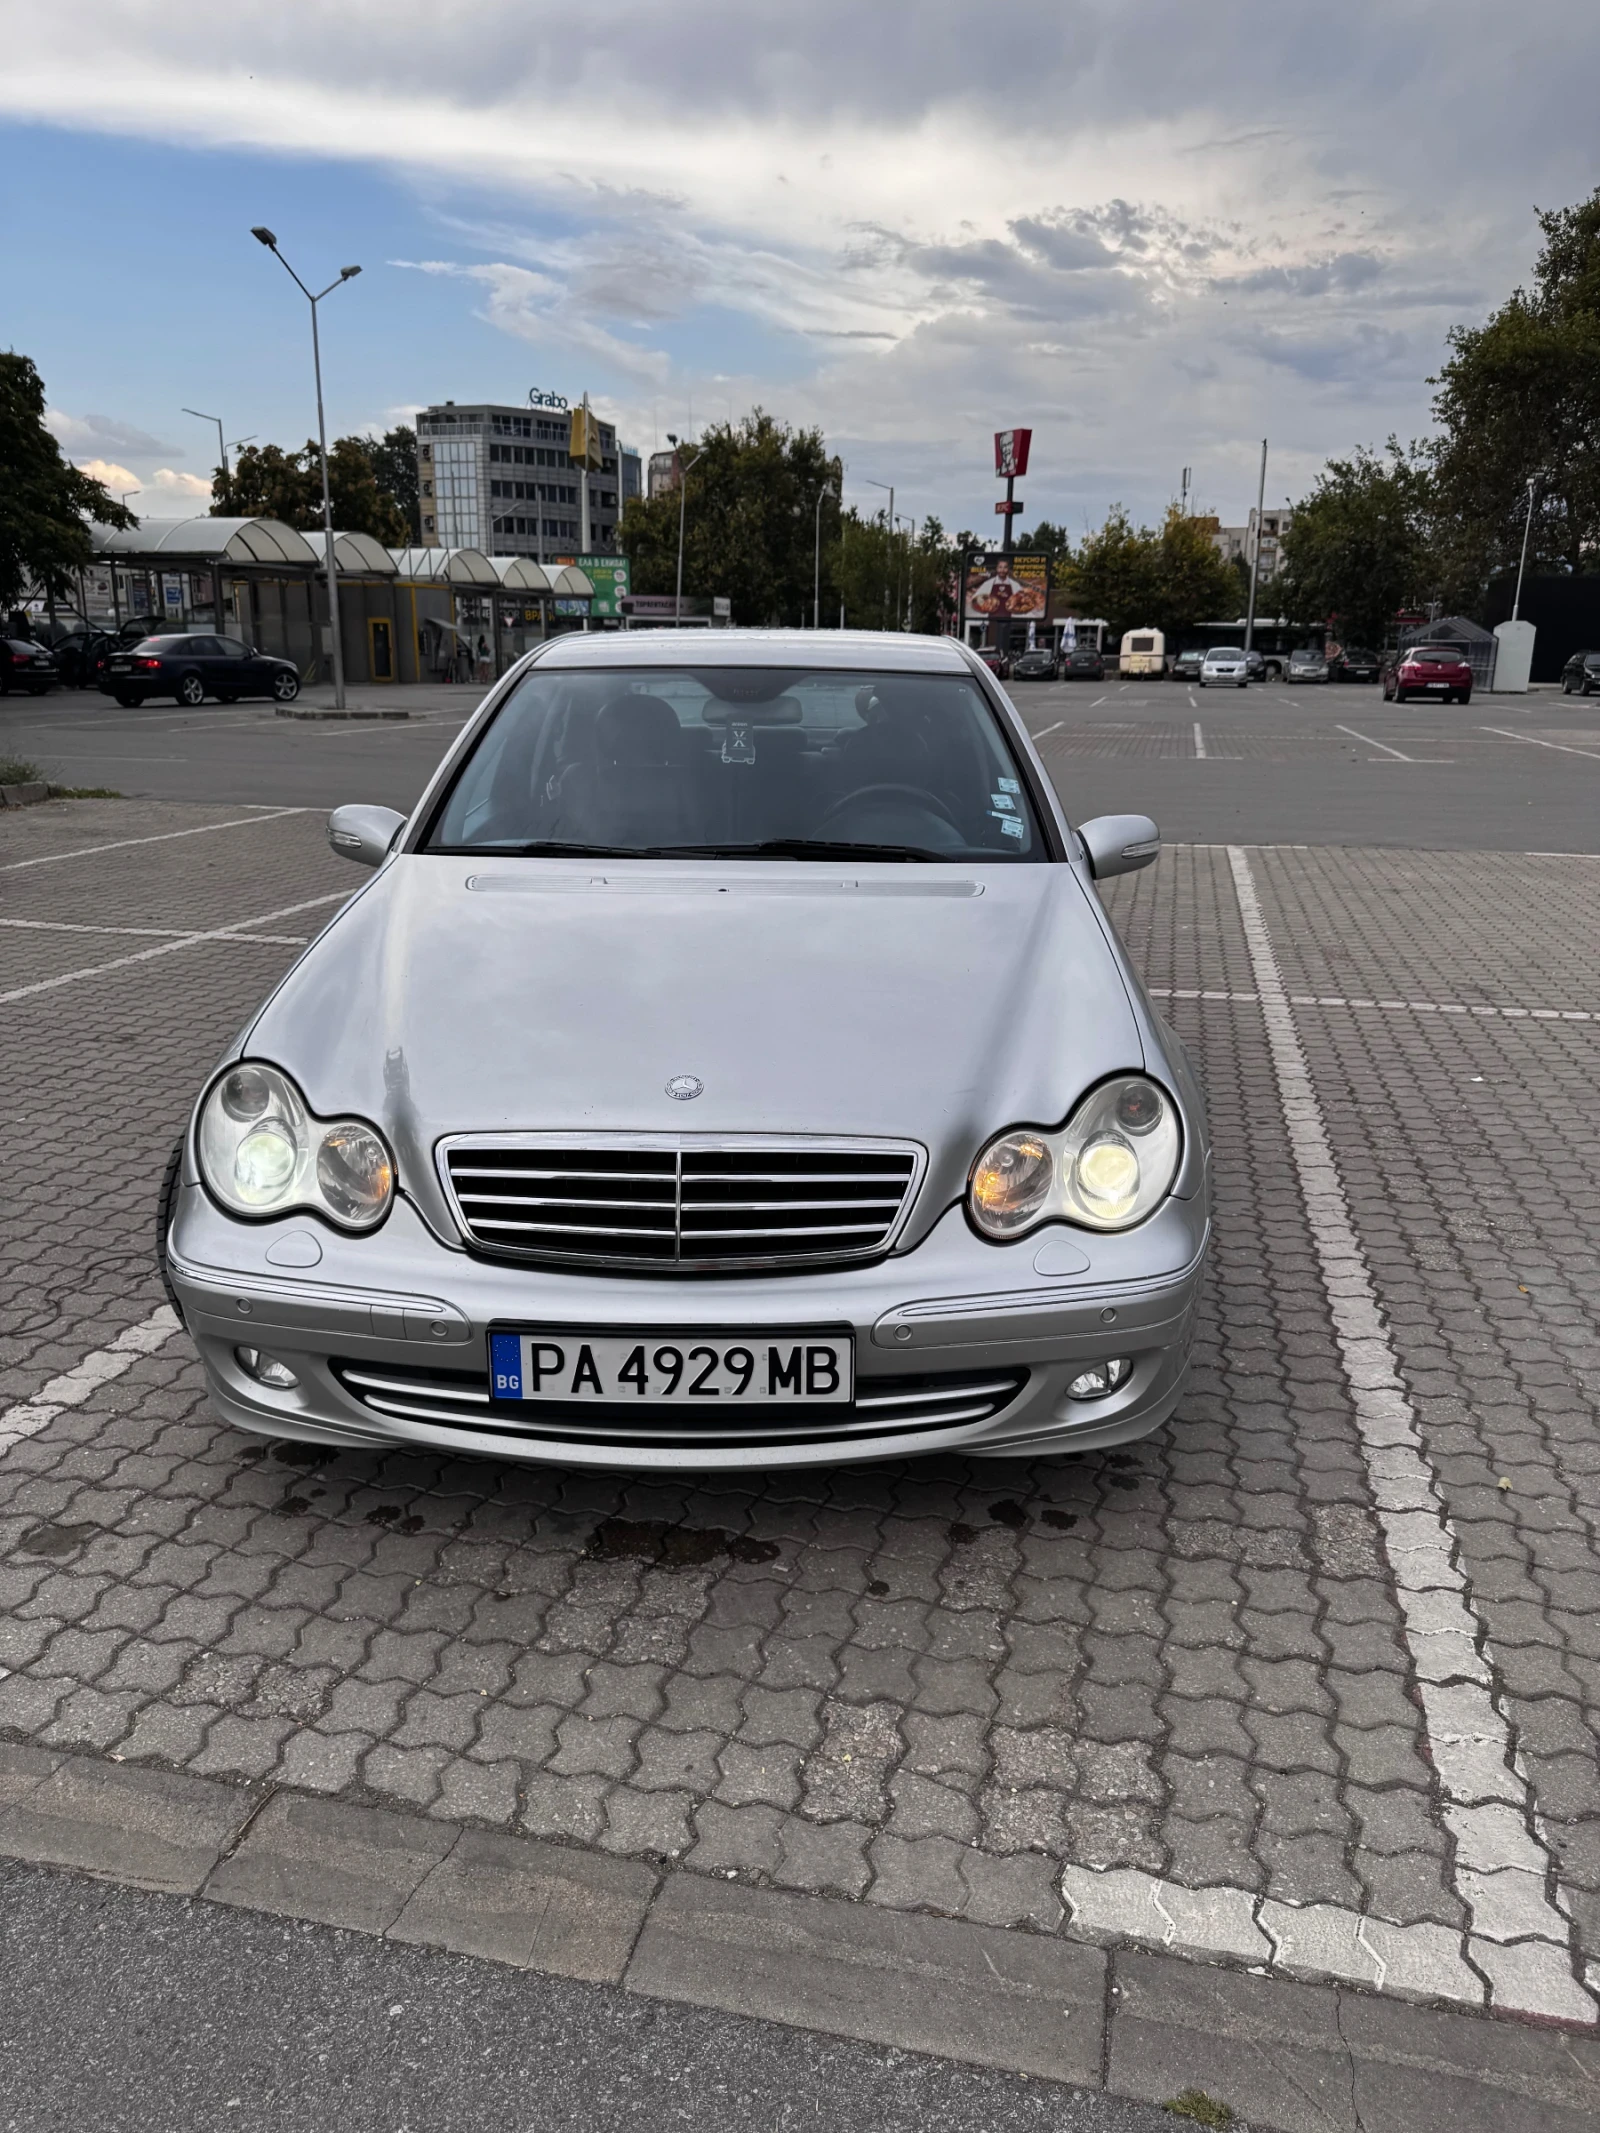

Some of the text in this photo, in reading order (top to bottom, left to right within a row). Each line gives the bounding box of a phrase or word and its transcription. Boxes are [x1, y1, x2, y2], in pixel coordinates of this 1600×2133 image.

[529, 387, 567, 409] Grabo
[531, 1342, 840, 1396] PA 4929 MB
[497, 1374, 520, 1390] BG
